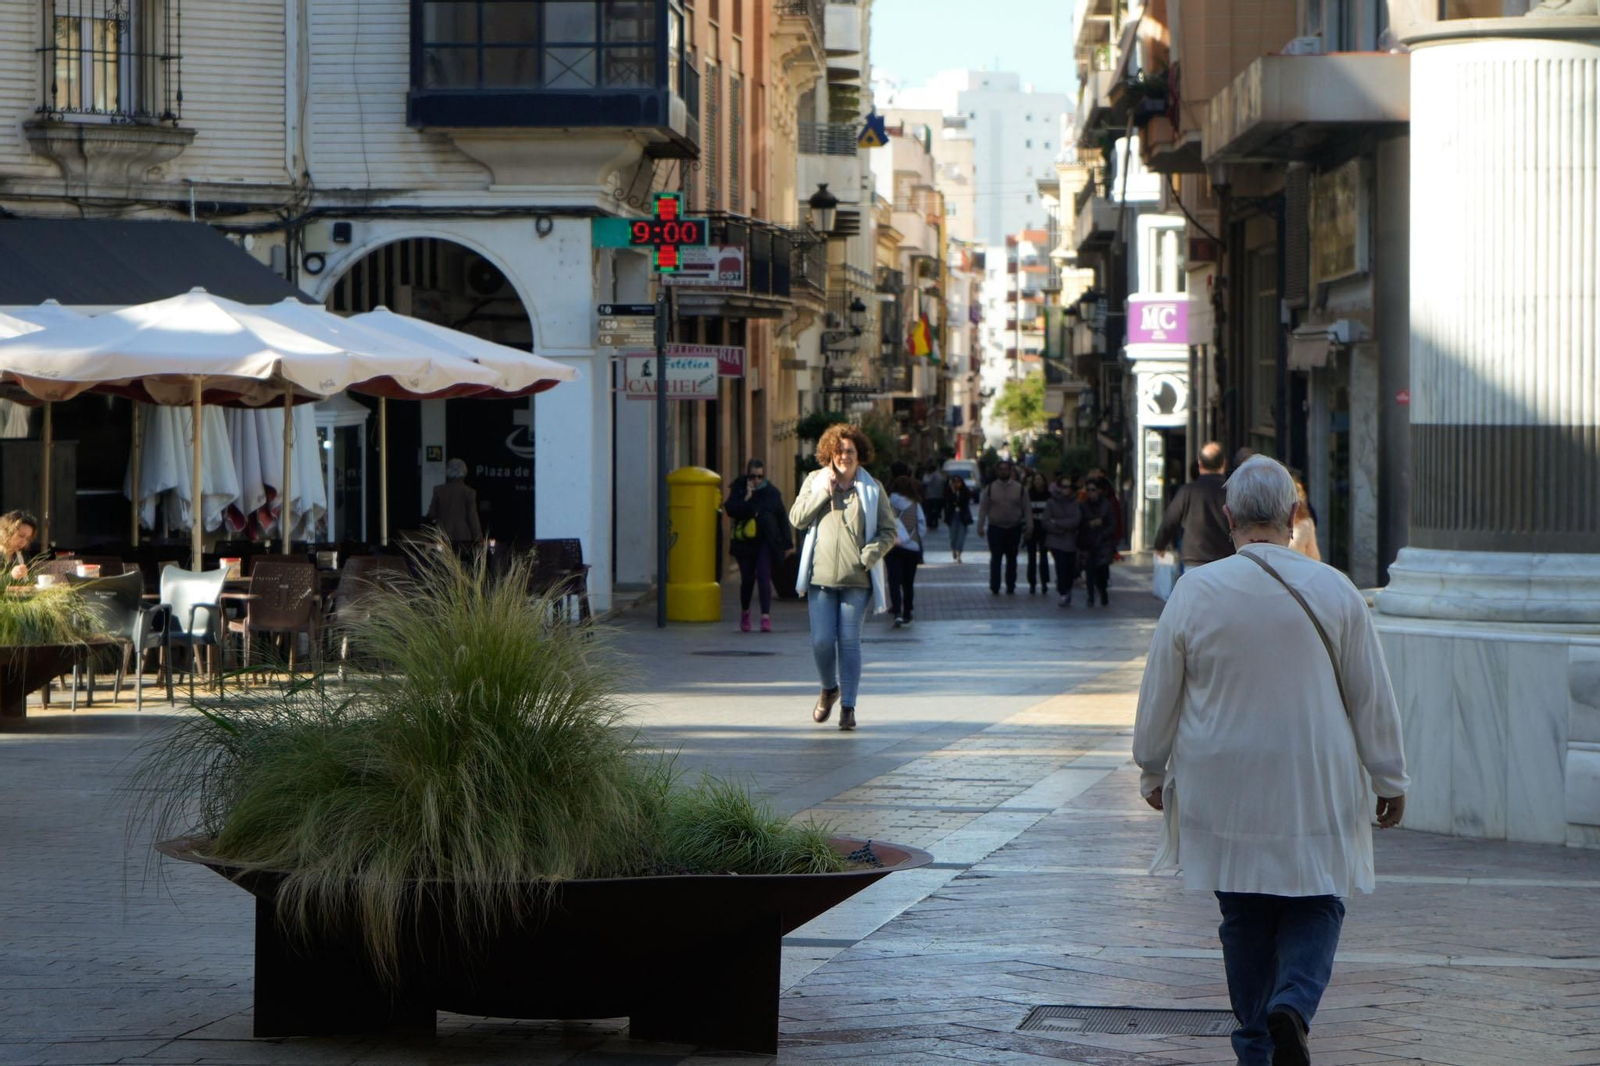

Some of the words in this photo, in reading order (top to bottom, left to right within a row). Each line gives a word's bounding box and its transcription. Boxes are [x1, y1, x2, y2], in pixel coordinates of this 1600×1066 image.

[633, 222, 697, 243] 9:00
[720, 271, 740, 280] CGT
[1140, 306, 1177, 330] MC
[628, 379, 702, 393] CAHEL
[475, 464, 511, 477] Plaza
[514, 464, 530, 477] de
